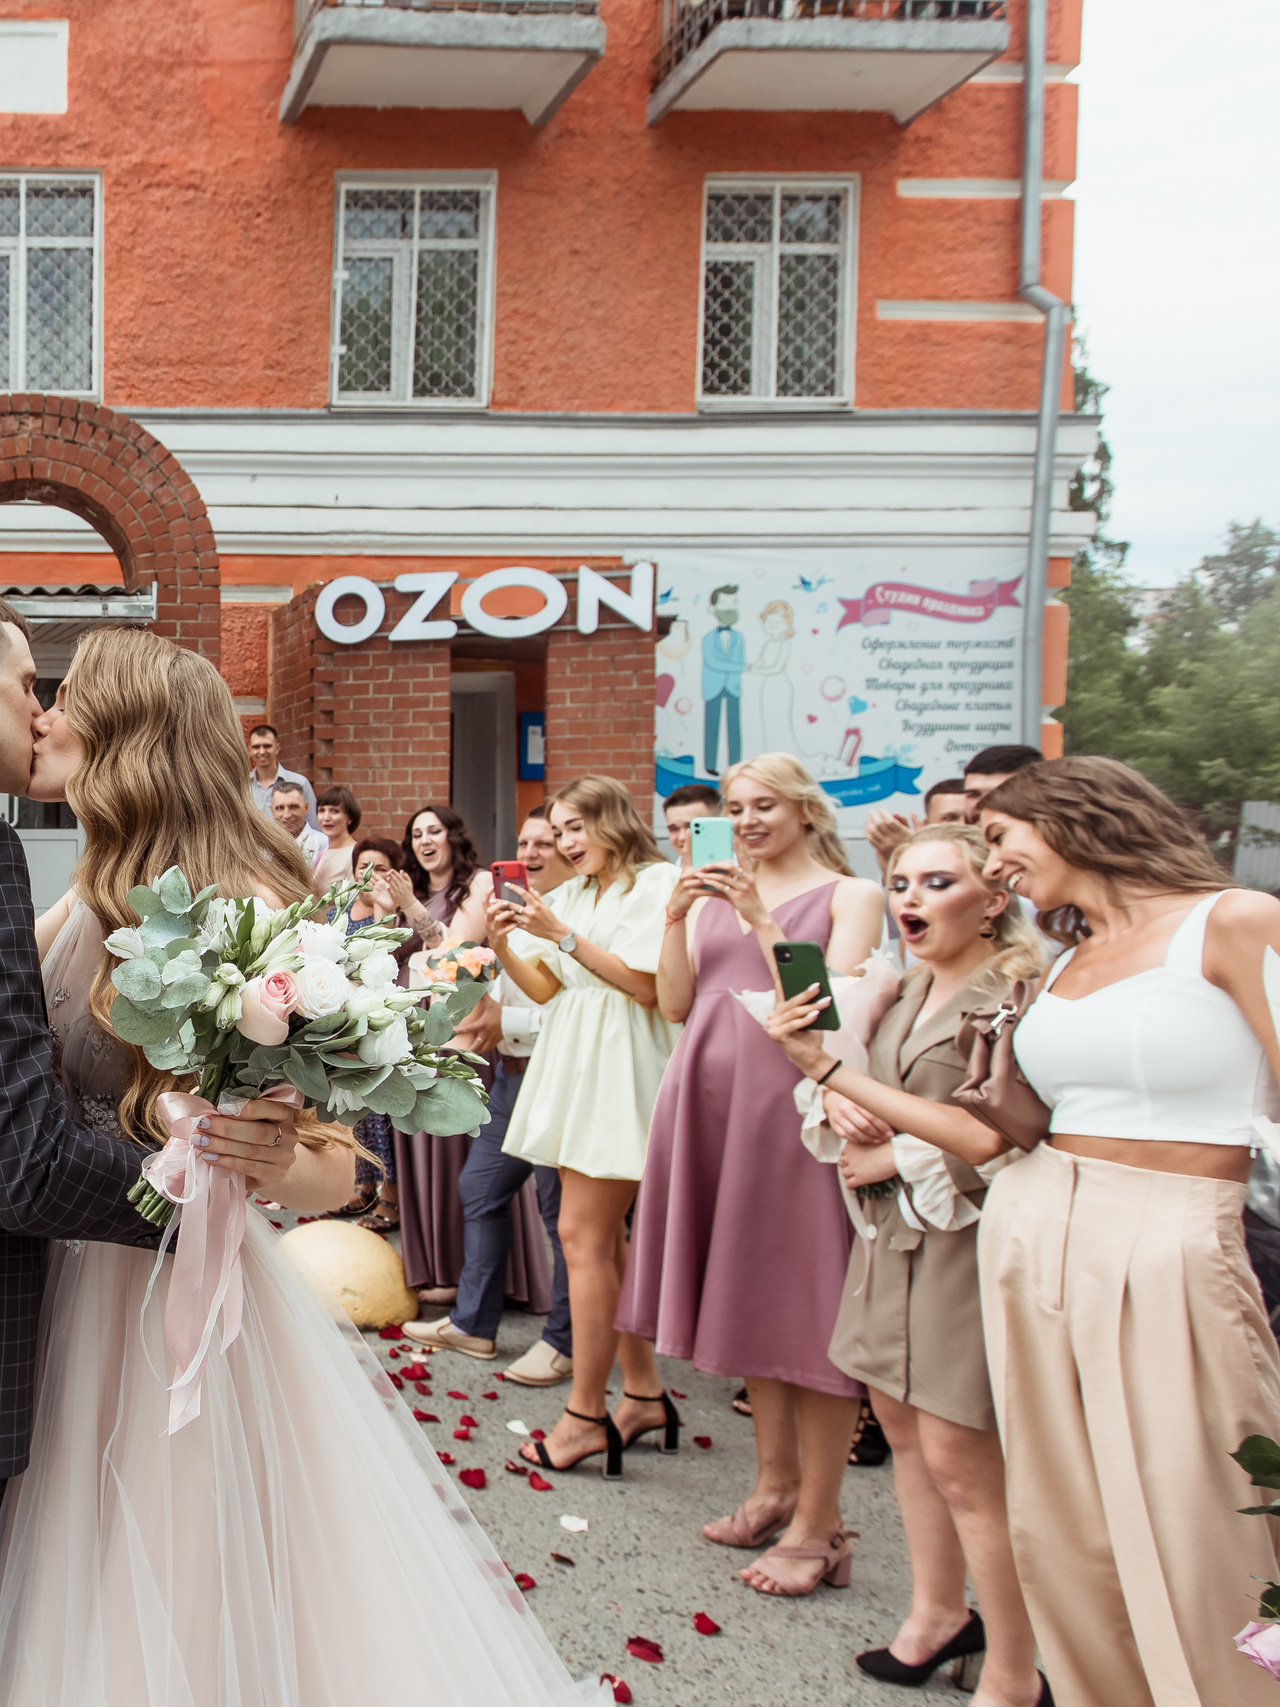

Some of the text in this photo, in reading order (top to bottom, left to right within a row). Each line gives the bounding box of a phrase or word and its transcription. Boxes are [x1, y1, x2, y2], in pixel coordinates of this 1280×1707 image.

[315, 562, 655, 644] OZON
[874, 585, 986, 618] Студия праздника
